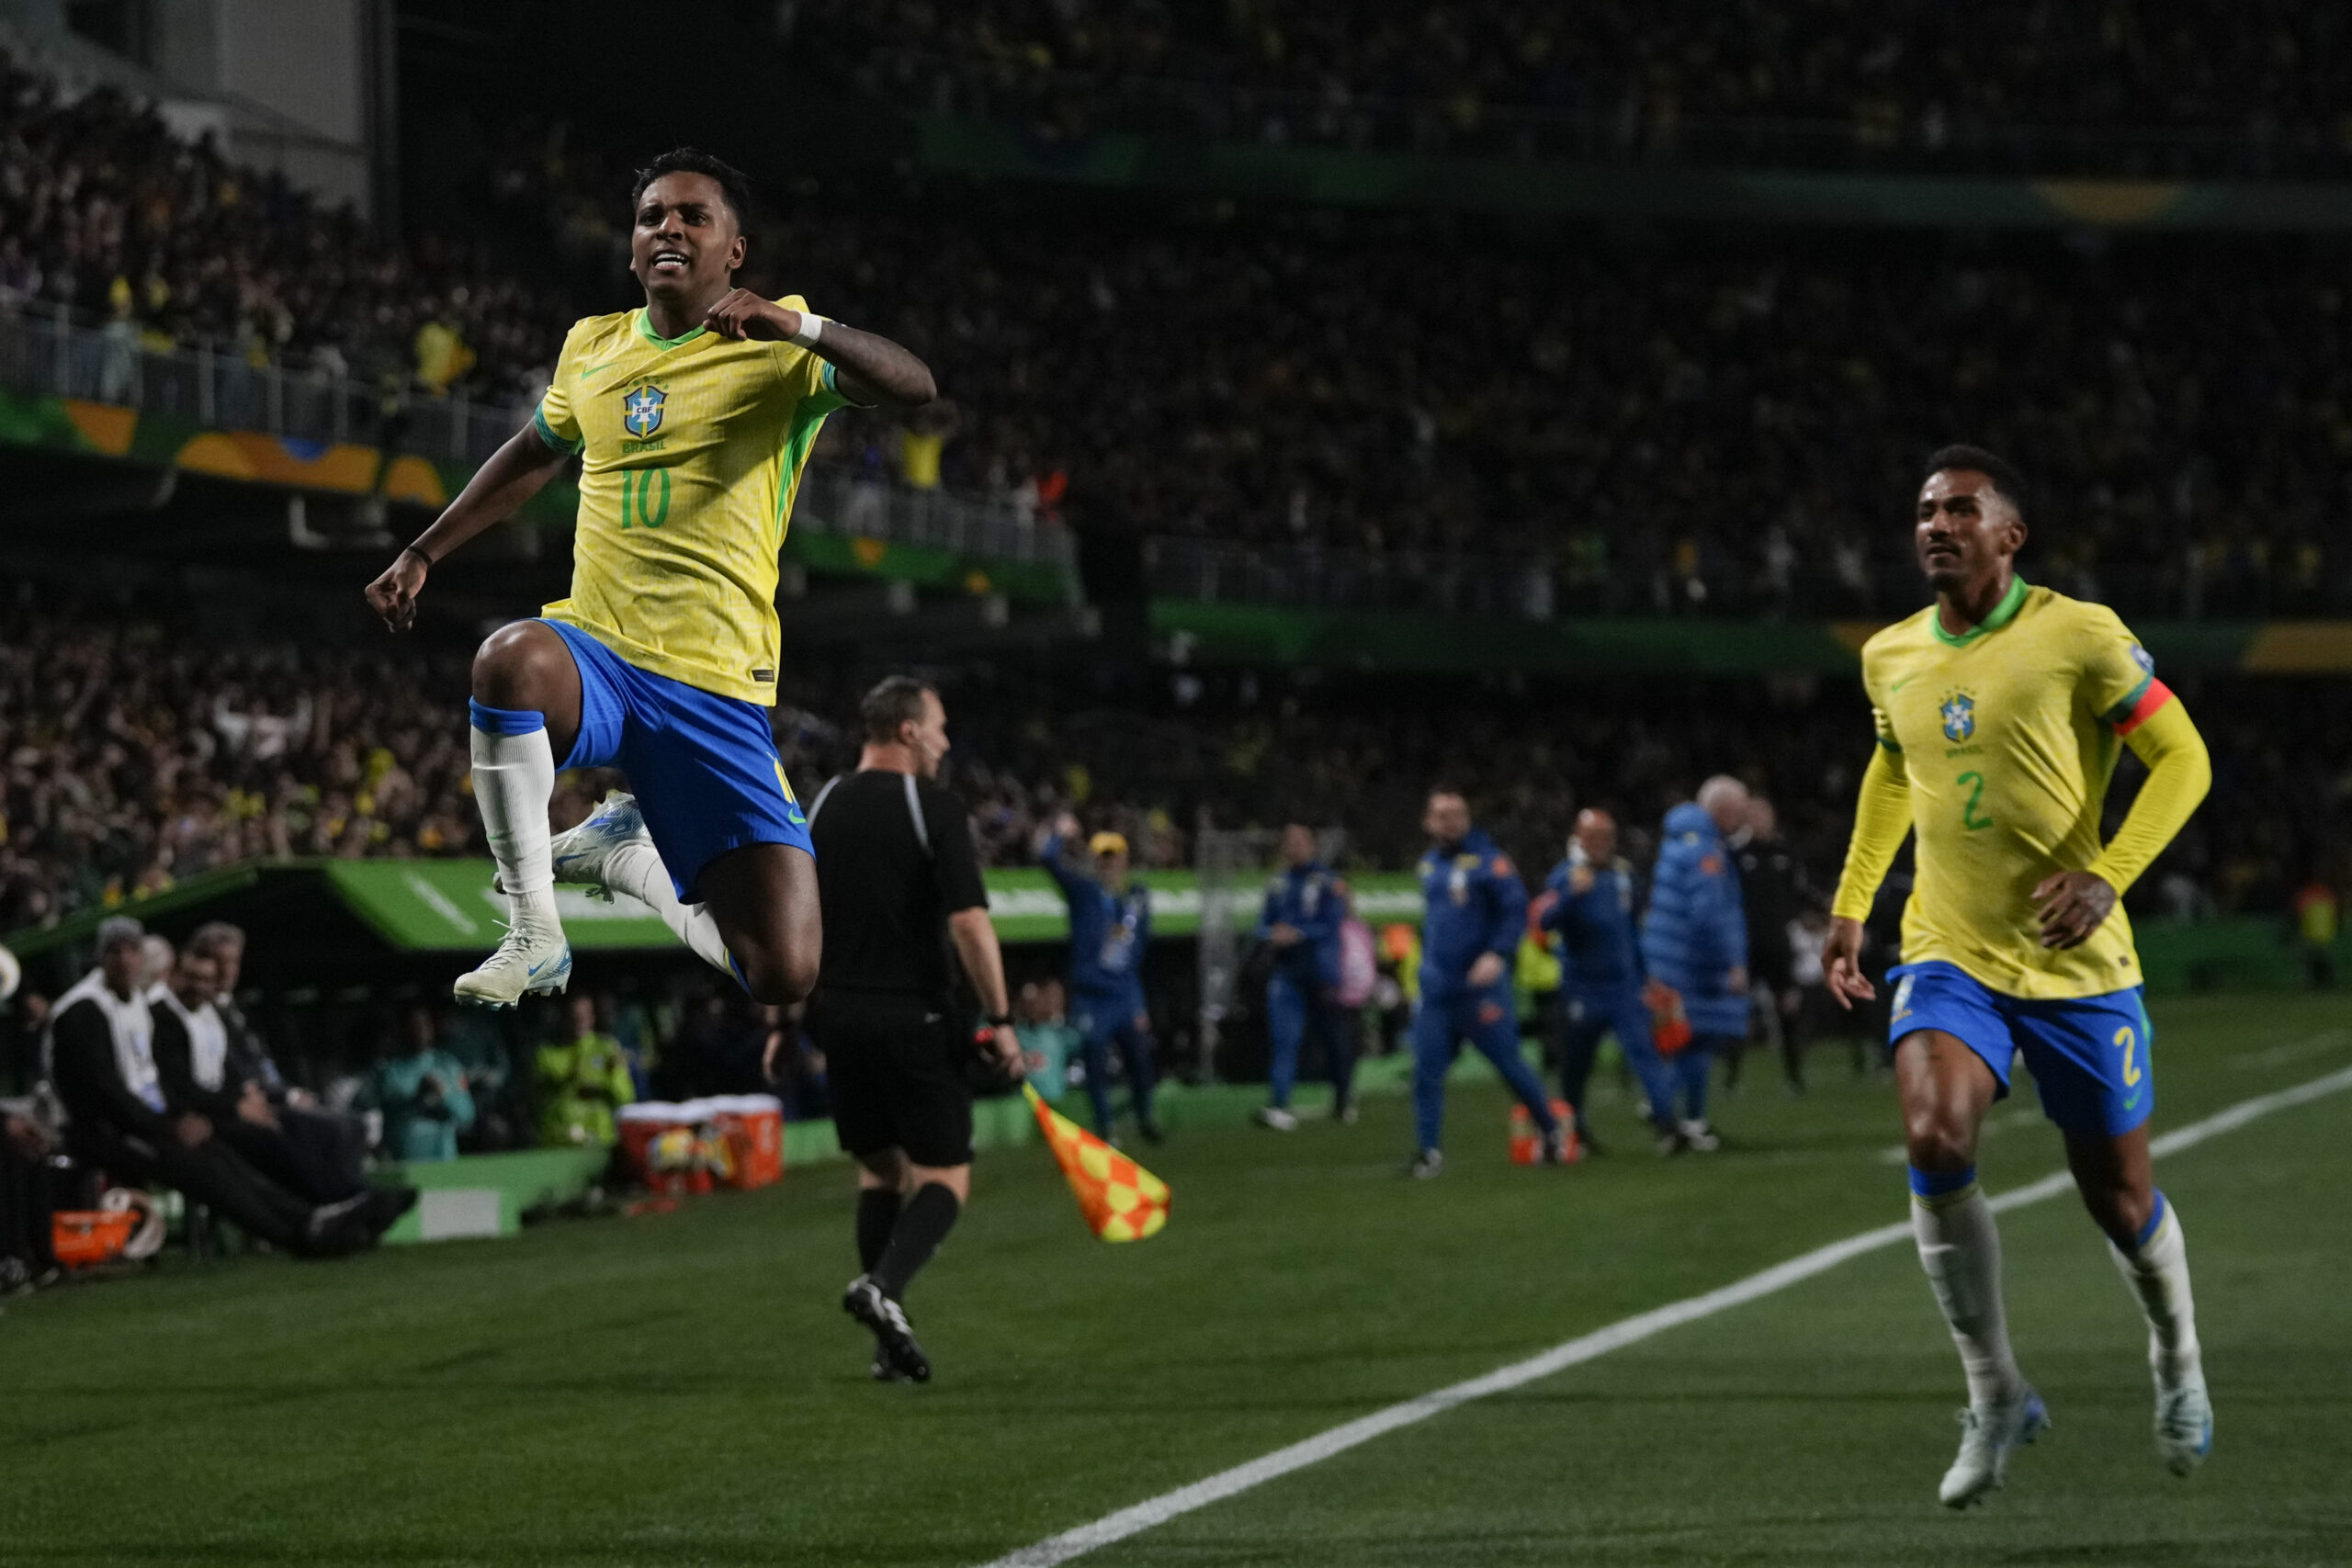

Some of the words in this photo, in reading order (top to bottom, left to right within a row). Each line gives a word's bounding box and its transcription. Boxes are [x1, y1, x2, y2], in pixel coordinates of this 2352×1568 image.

[622, 441, 667, 454] BRASIL
[622, 468, 671, 529] 10
[1957, 771, 1994, 830] 2
[2113, 1026, 2142, 1087] 2
